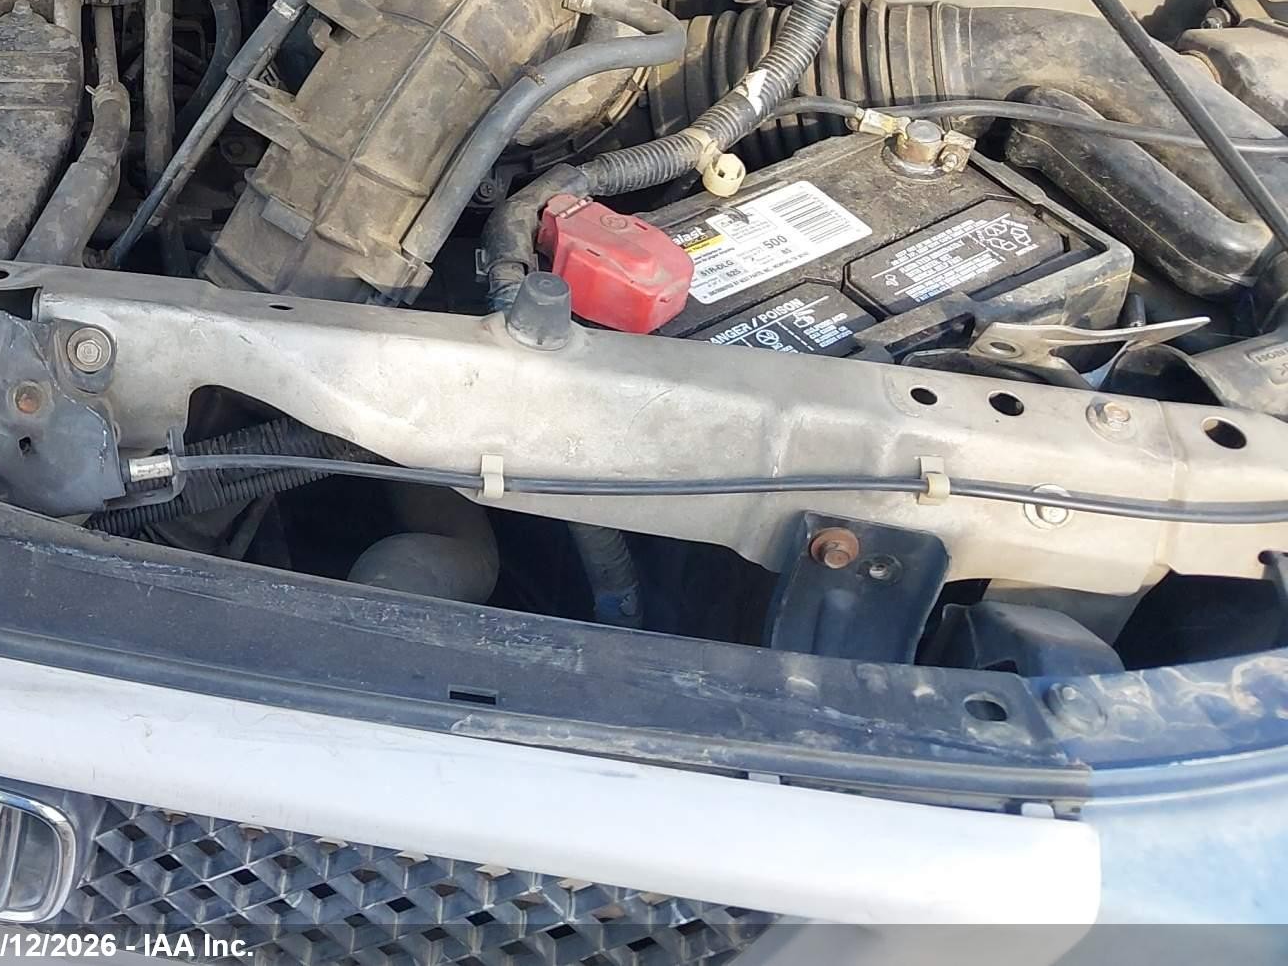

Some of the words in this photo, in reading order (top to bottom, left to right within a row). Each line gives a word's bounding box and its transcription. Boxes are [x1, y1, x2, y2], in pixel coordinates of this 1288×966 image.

[762, 235, 788, 250] 500
[710, 322, 752, 346] ANGER
[760, 298, 805, 323] POISON
